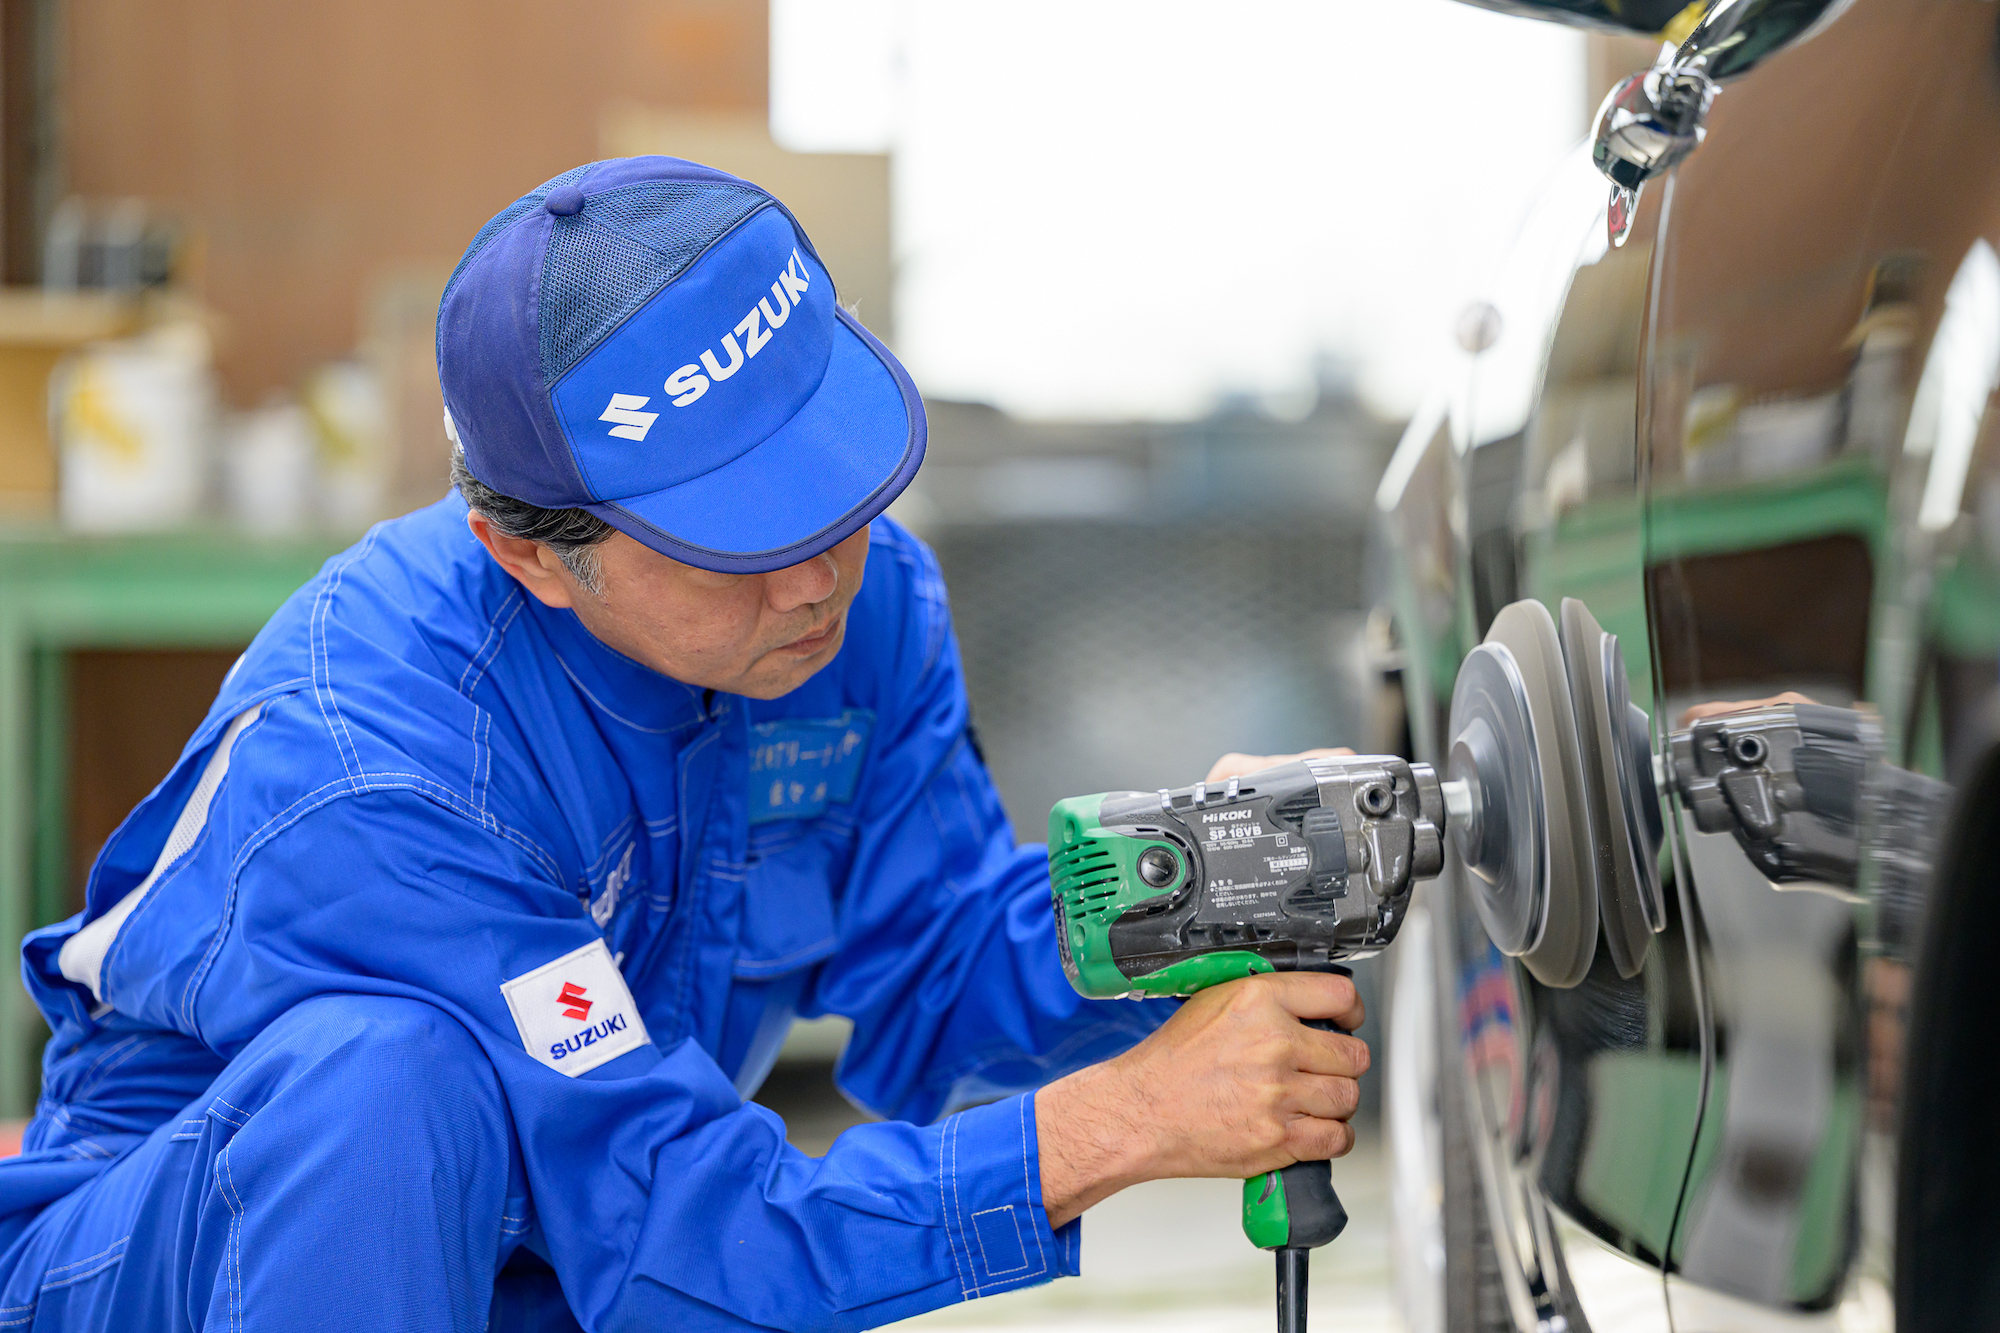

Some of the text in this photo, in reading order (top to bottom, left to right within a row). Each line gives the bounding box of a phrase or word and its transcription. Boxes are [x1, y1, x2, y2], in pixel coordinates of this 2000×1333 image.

[664, 247, 810, 407] SUZUKI
[1202, 809, 1252, 823] HiKOKI
[1209, 825, 1262, 841] SP 18VB
[549, 1013, 627, 1060] SUZUKI
